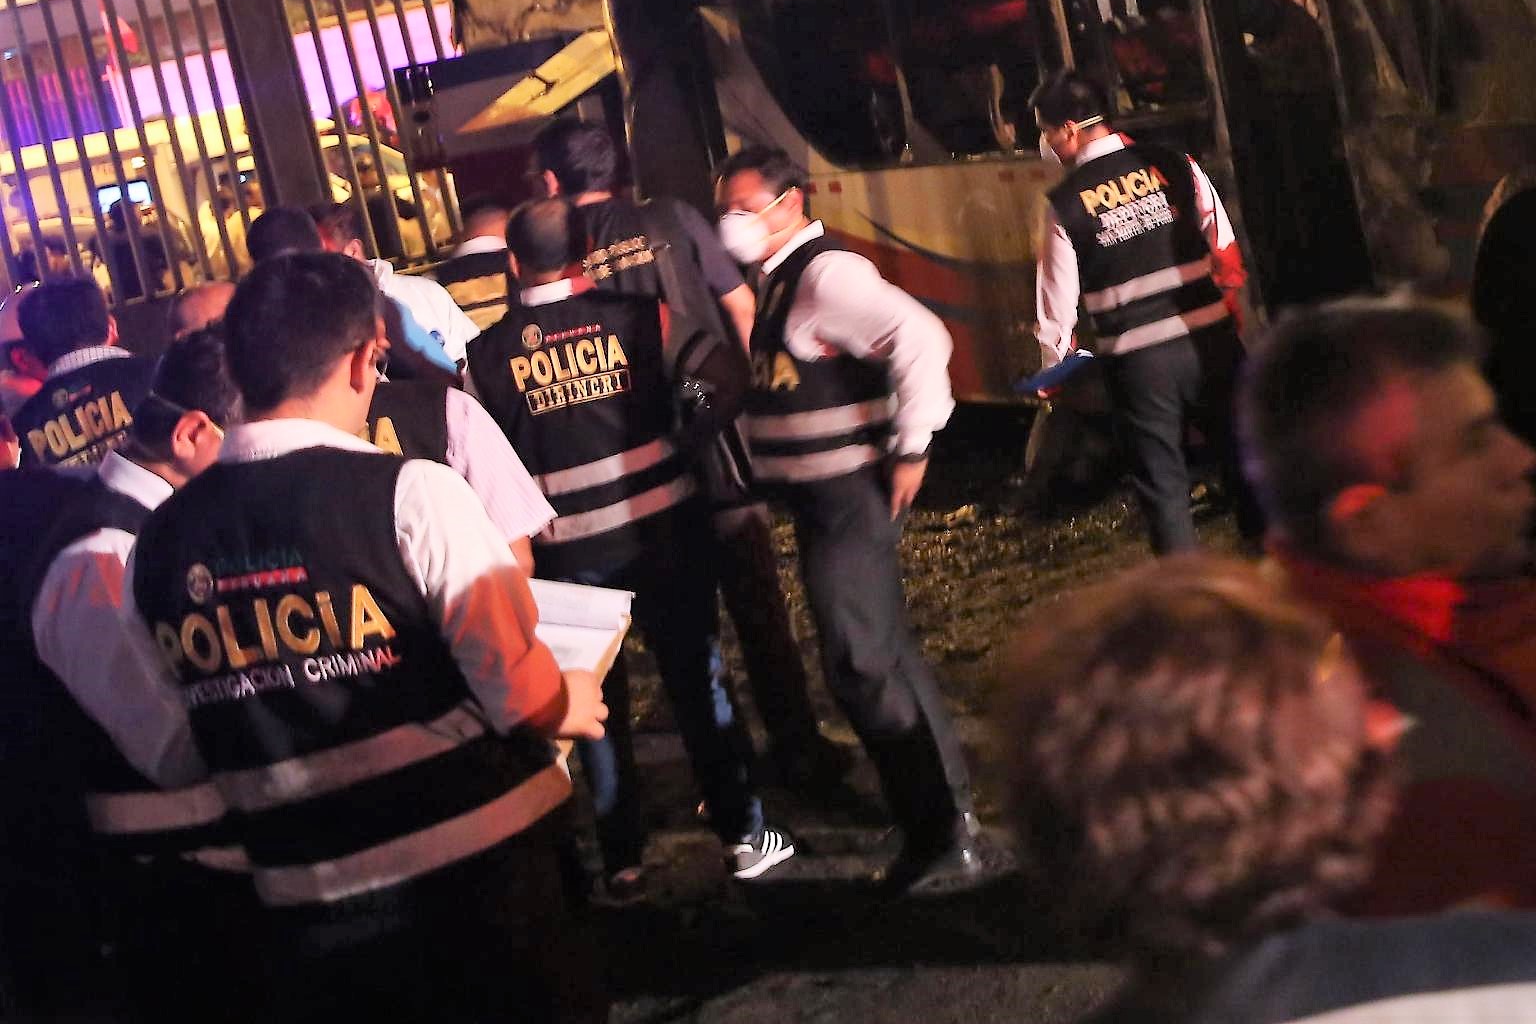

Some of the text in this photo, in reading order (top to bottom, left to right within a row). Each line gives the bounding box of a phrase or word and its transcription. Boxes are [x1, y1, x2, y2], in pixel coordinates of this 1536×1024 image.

[1079, 166, 1169, 218] POLICIA
[509, 334, 629, 393] POLICIA
[27, 390, 134, 463] POLICIA
[303, 646, 401, 683] CRIMINAL
